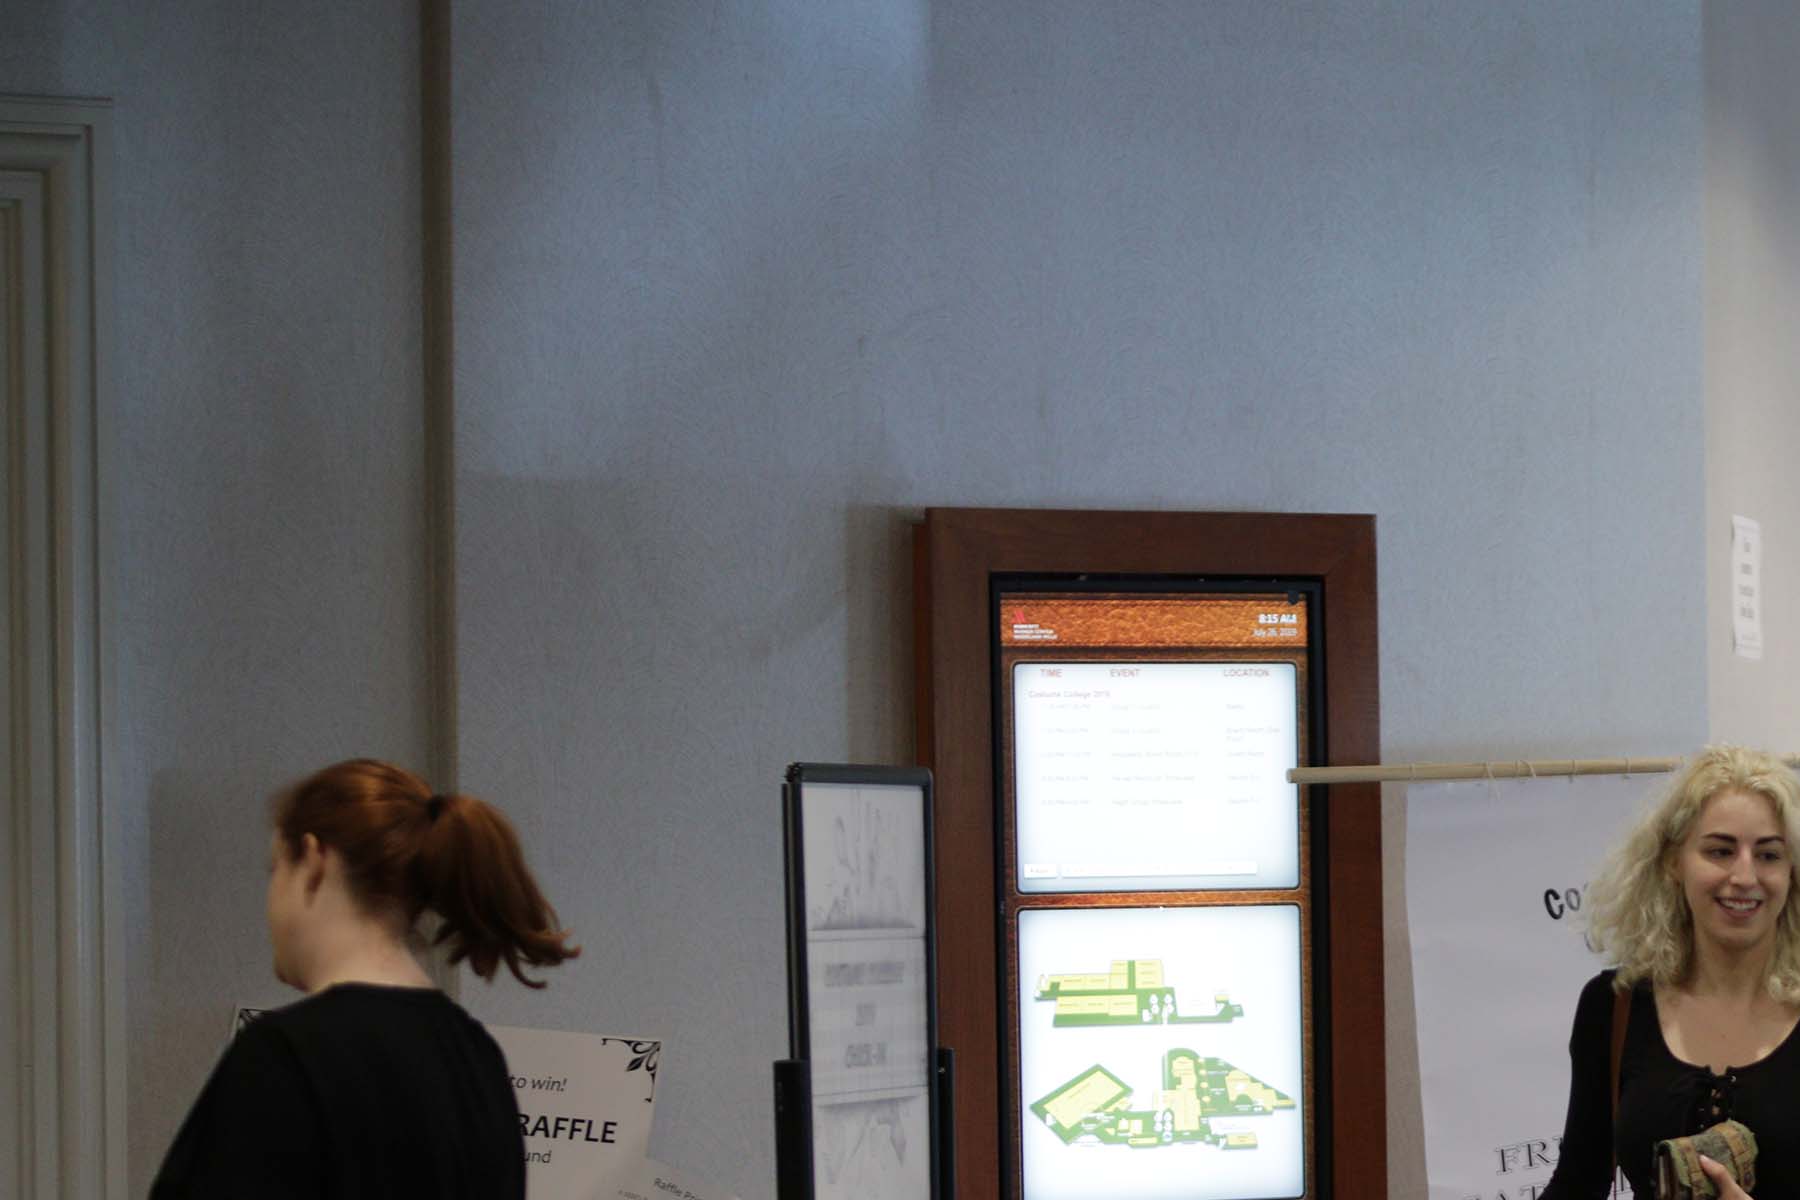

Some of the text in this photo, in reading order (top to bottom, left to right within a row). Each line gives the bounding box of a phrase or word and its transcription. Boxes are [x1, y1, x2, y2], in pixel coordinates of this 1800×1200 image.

[1040, 668, 1062, 678] TIME
[1110, 668, 1141, 678] EVENT
[1223, 668, 1270, 678] LOCATION
[532, 1075, 568, 1092] win!
[653, 1177, 683, 1197] Raffle
